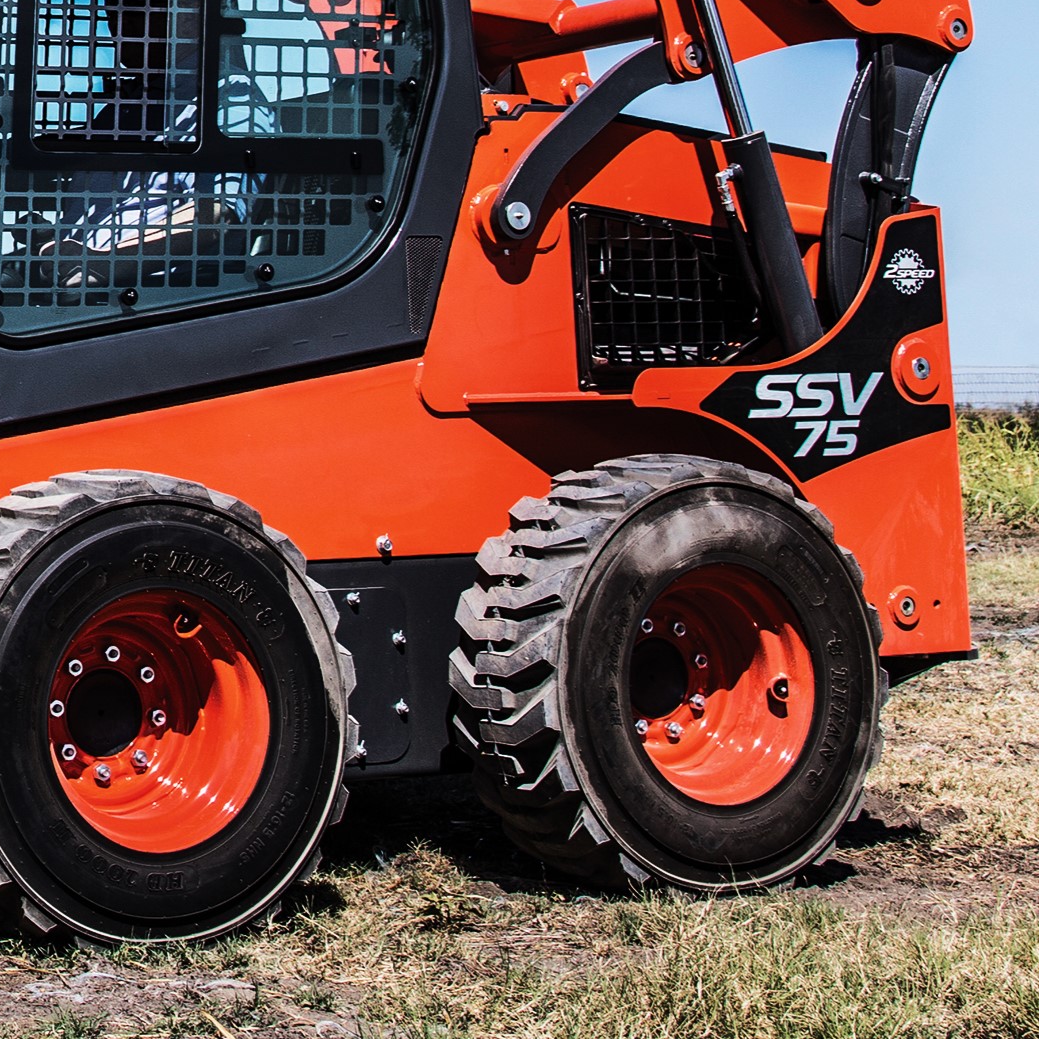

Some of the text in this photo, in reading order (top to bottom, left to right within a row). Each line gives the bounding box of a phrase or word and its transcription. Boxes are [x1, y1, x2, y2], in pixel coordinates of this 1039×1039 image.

[748, 372, 884, 418] SSV
[793, 420, 860, 457] 75
[167, 550, 256, 603] TITAN
[819, 667, 850, 763] TITAN
[145, 871, 184, 893] HD
